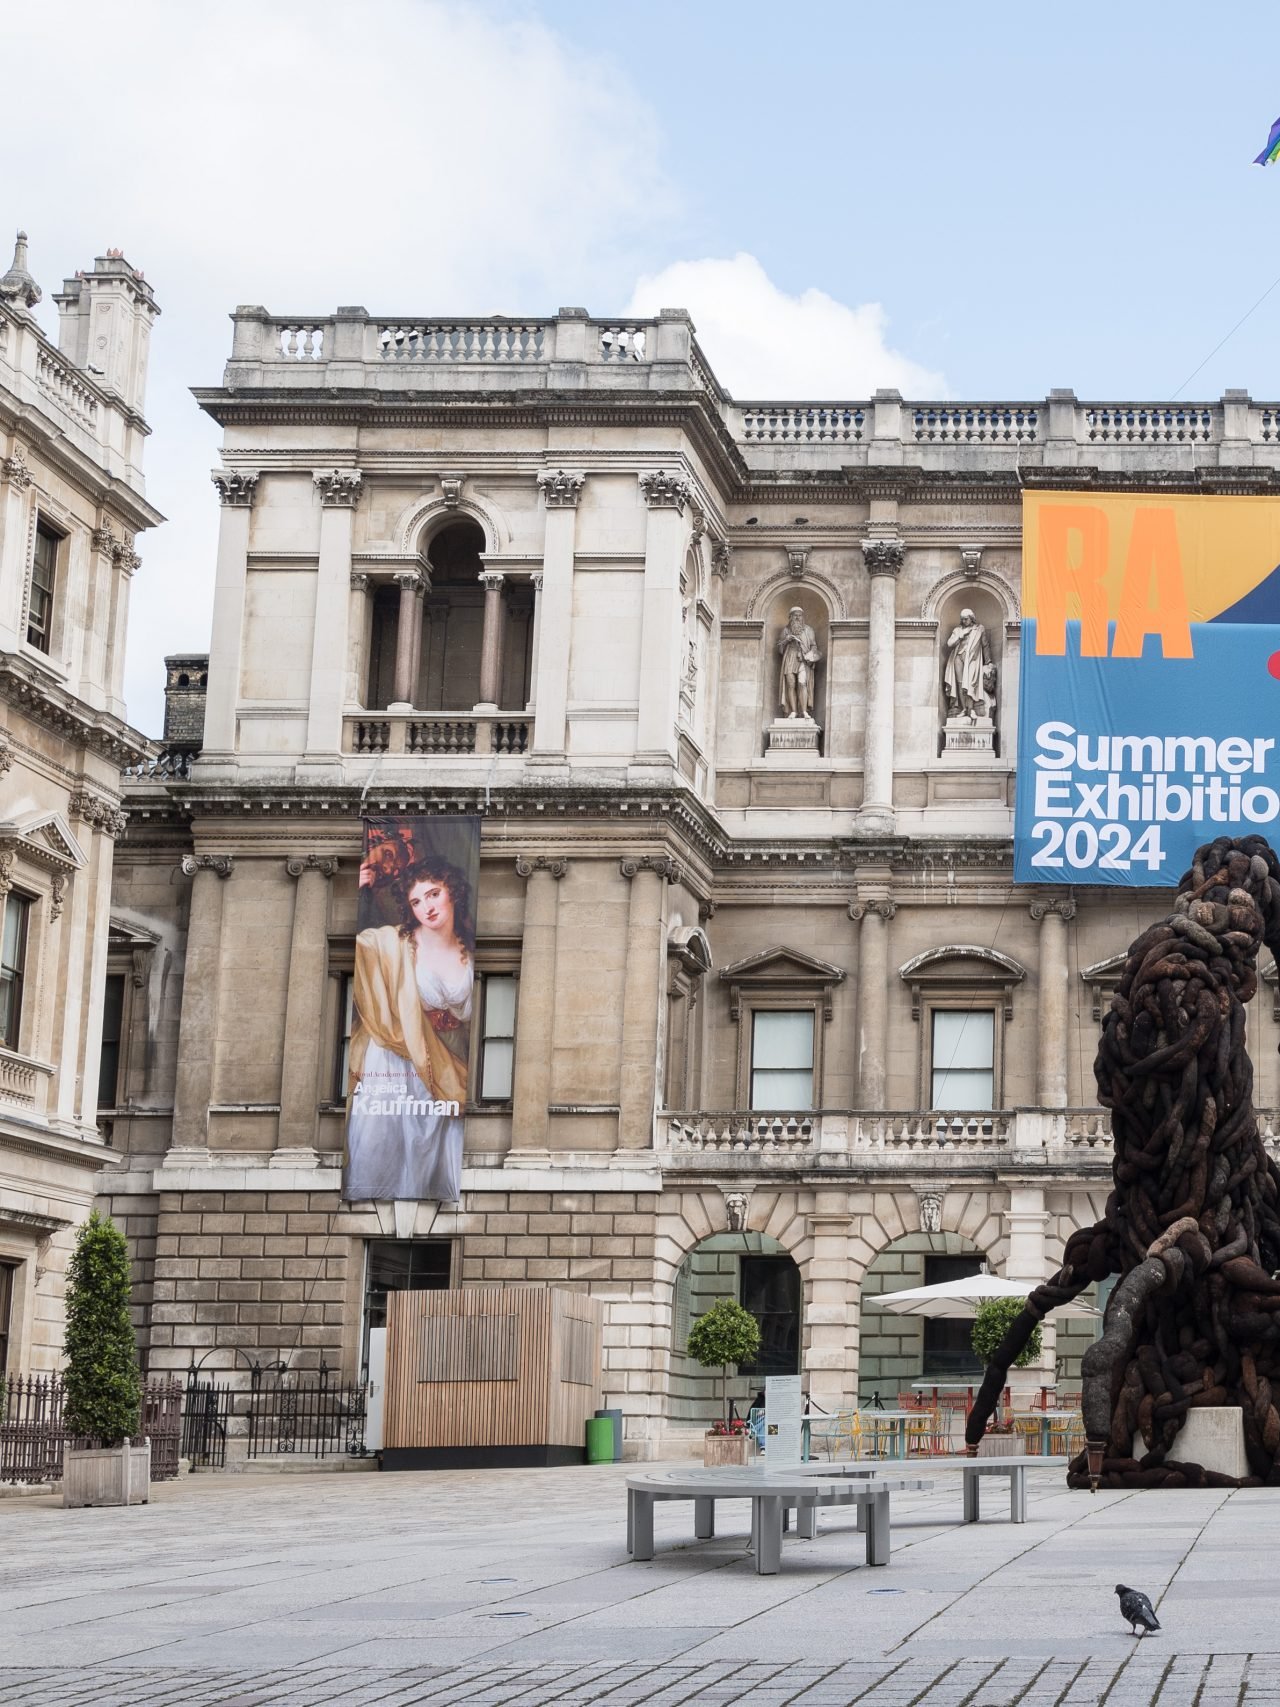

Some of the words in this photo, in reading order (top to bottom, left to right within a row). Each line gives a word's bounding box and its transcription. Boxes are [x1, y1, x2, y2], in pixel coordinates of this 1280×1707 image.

[1036, 504, 1194, 659] RA
[1033, 721, 1275, 774] Summer
[1031, 821, 1166, 871] 2024
[352, 1095, 460, 1117] Kauffman
[353, 1081, 408, 1096] Angelica
